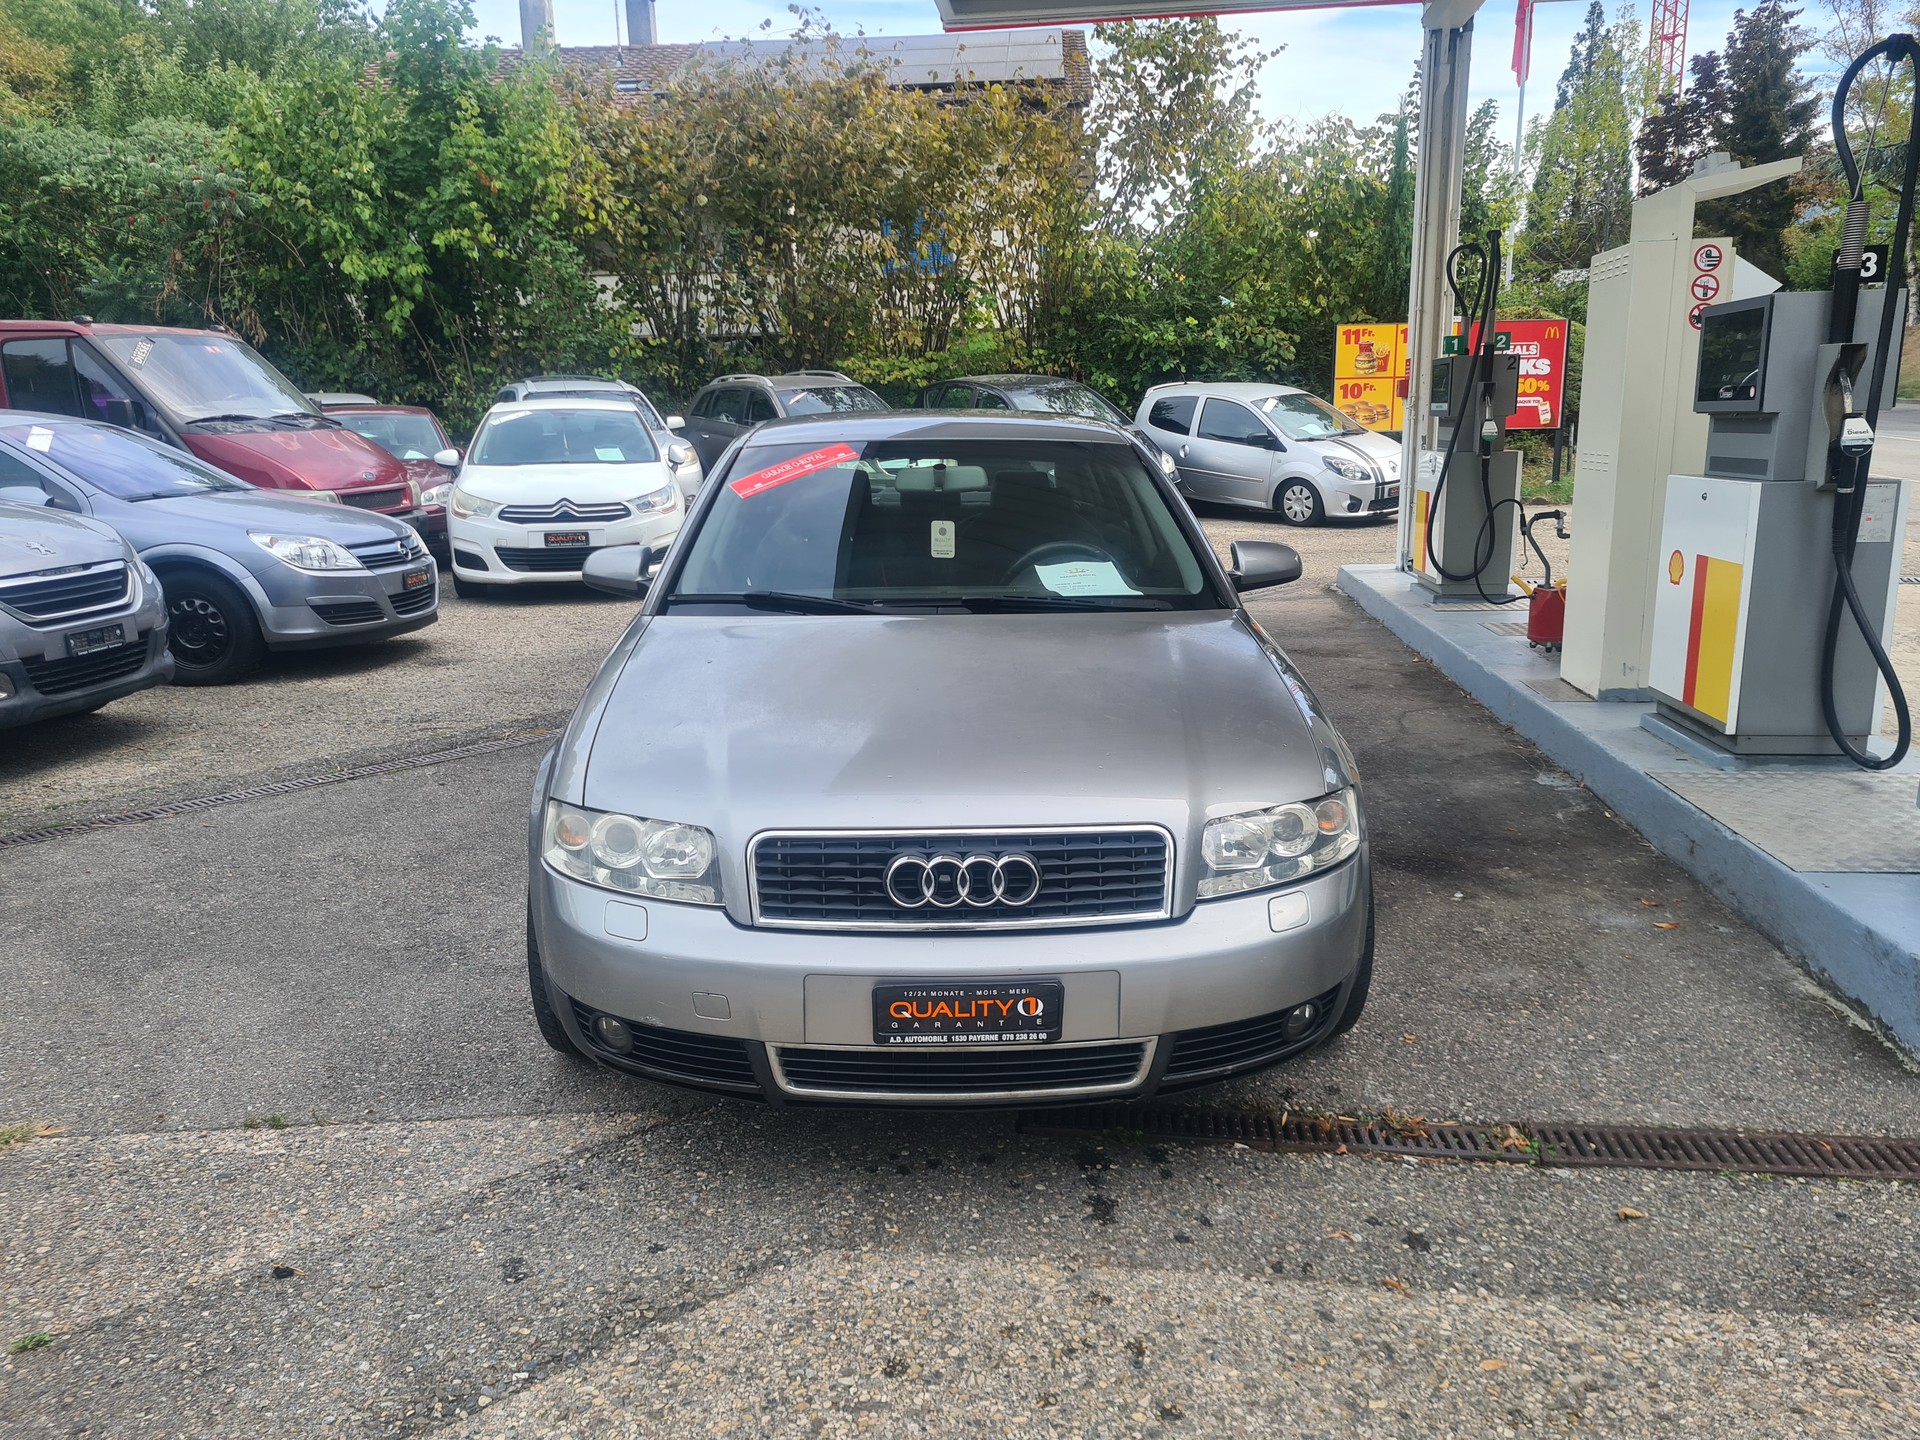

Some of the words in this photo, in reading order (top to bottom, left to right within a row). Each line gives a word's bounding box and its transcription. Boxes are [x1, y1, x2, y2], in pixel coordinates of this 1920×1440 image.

[1860, 252, 1878, 277] 3
[1342, 329, 1361, 345] 11
[1451, 338, 1458, 351] 1
[1496, 335, 1507, 348] 2
[134, 342, 150, 364] DIESEL
[1506, 355, 1517, 370] 2
[1339, 383, 1363, 399] 10
[889, 999, 1015, 1018] QUALITY
[891, 1019, 1042, 1029] GARANTIE
[904, 1035, 948, 1043] AUTOMOBILE
[968, 1034, 999, 1042] PAYERNE
[1038, 1032, 1048, 1040] 00
